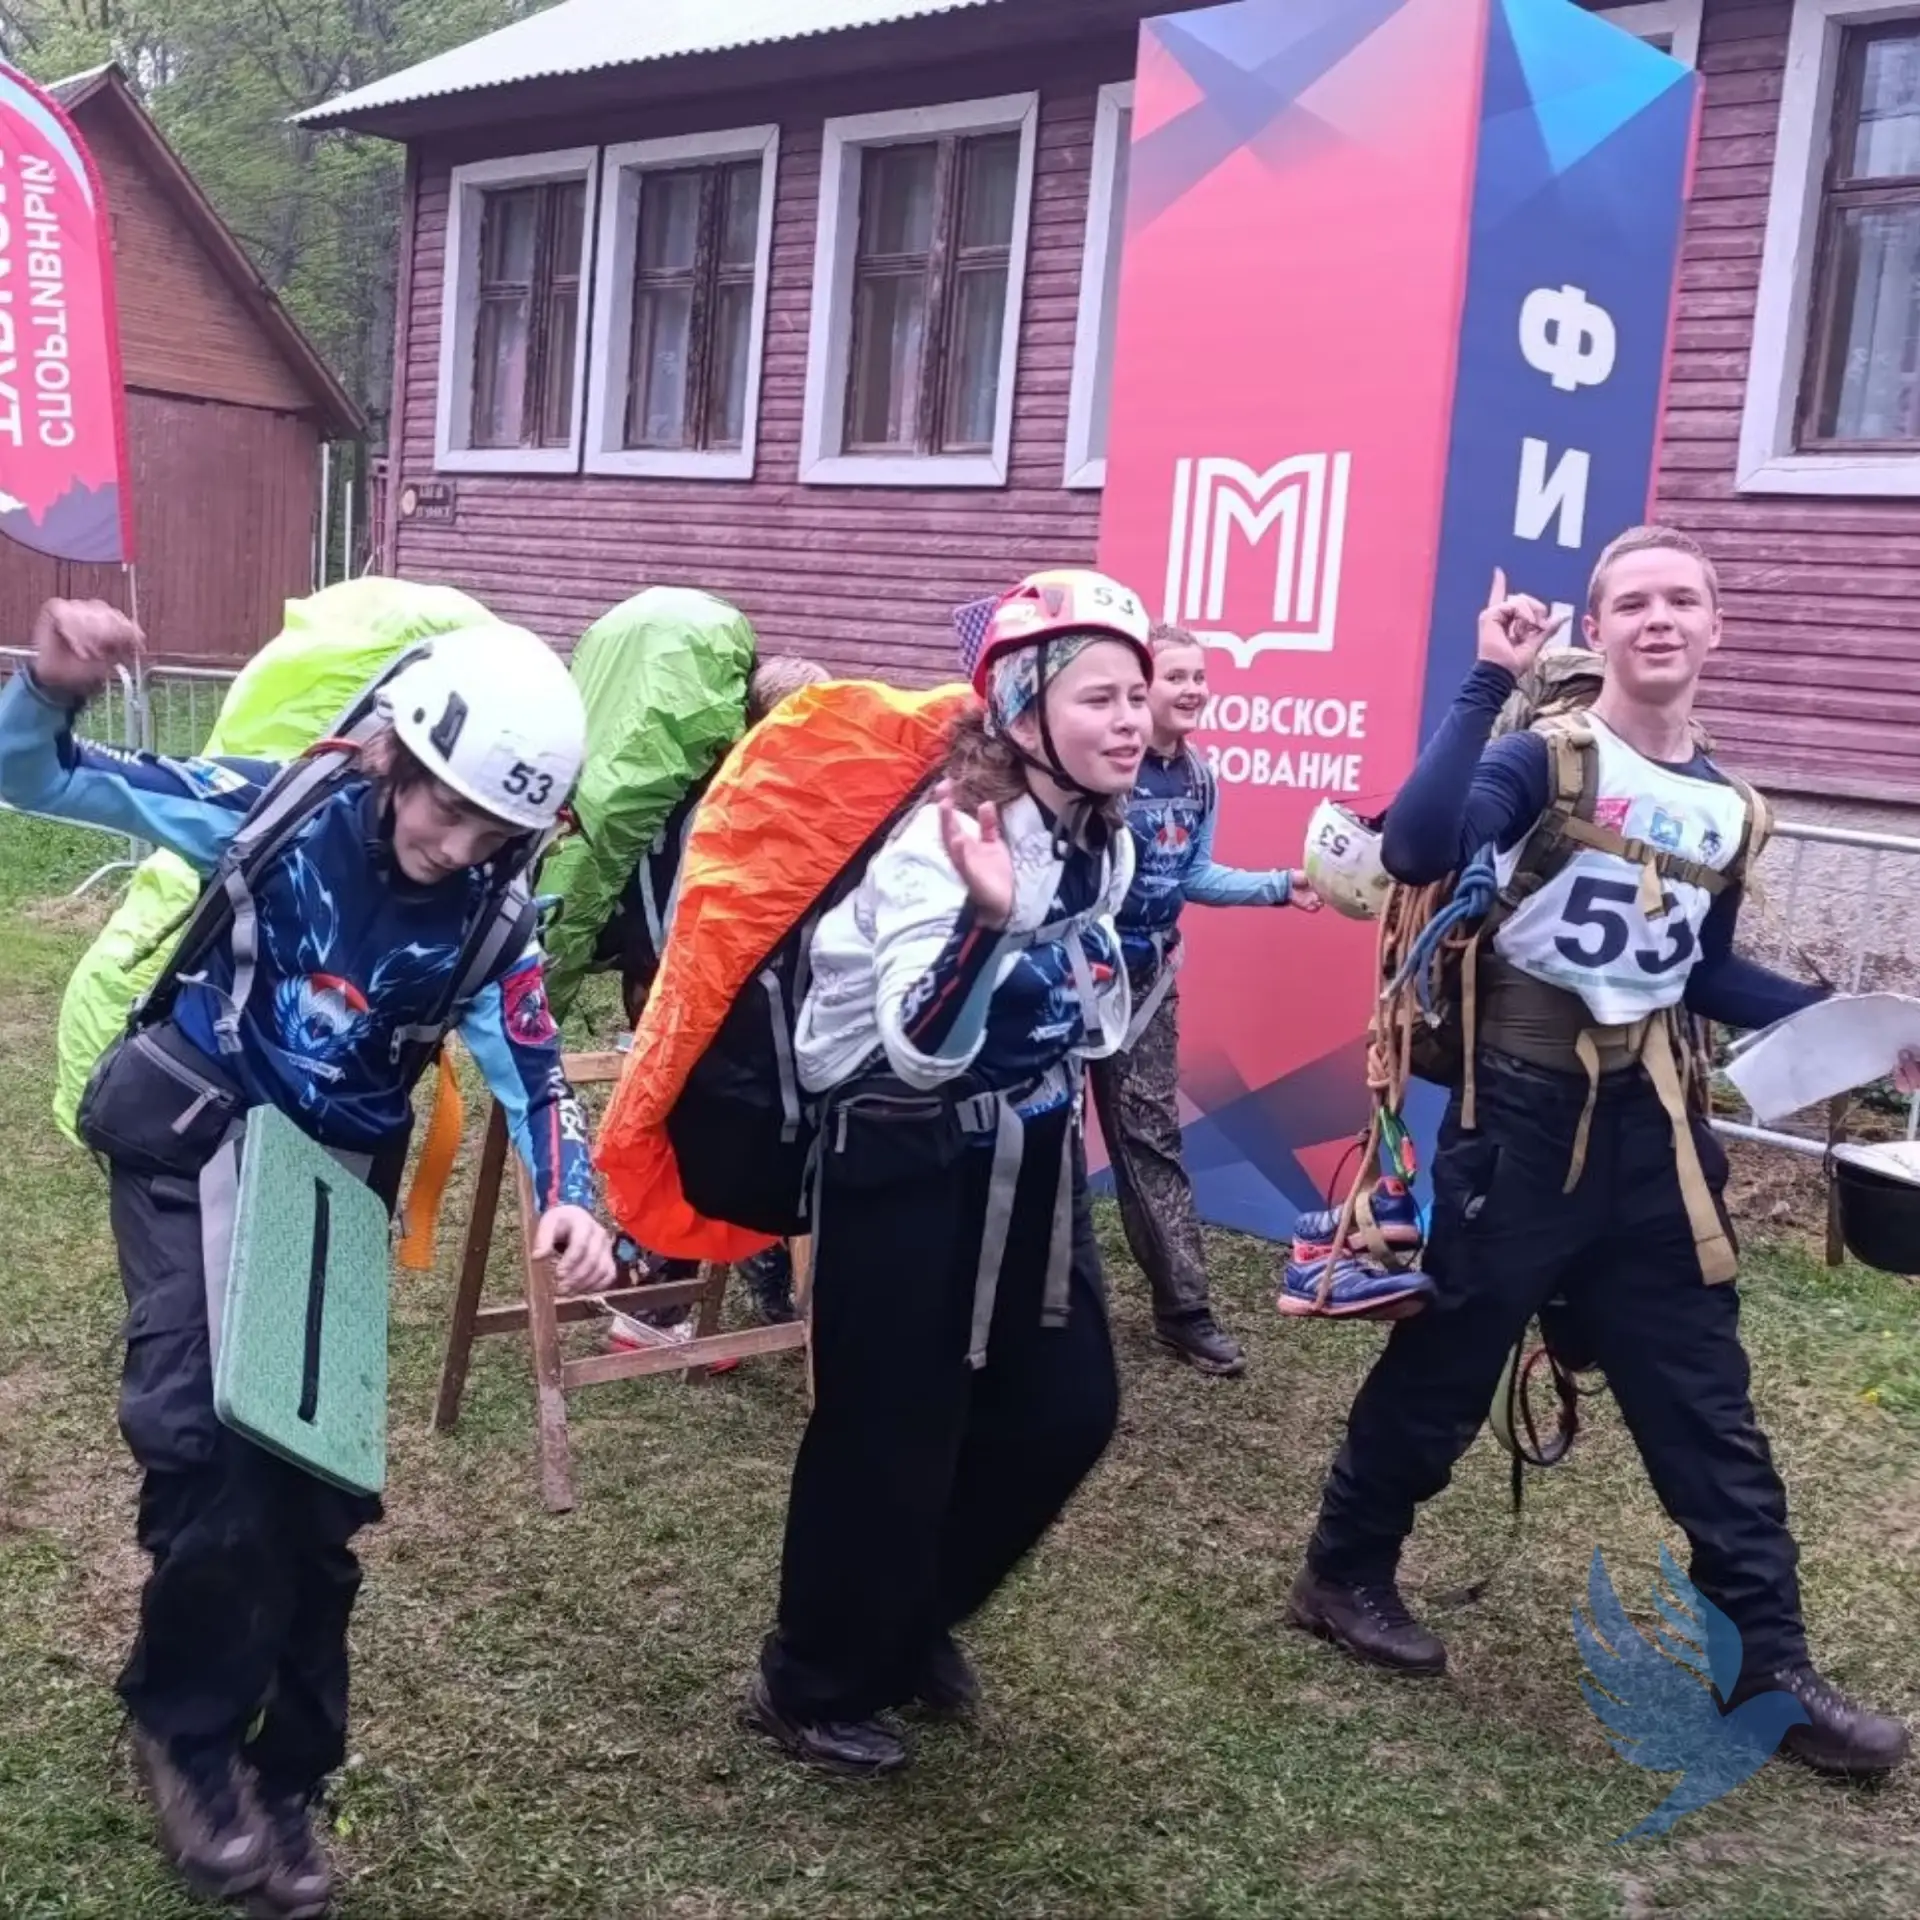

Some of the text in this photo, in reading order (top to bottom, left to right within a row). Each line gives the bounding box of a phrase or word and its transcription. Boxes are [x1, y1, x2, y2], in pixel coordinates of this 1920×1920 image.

[1199, 694, 1367, 739] КОВСКОЕ
[502, 761, 554, 805] 53
[1206, 744, 1363, 792] ЗОВАНИЕ
[1319, 822, 1350, 857] 53
[1554, 875, 1695, 975] 53
